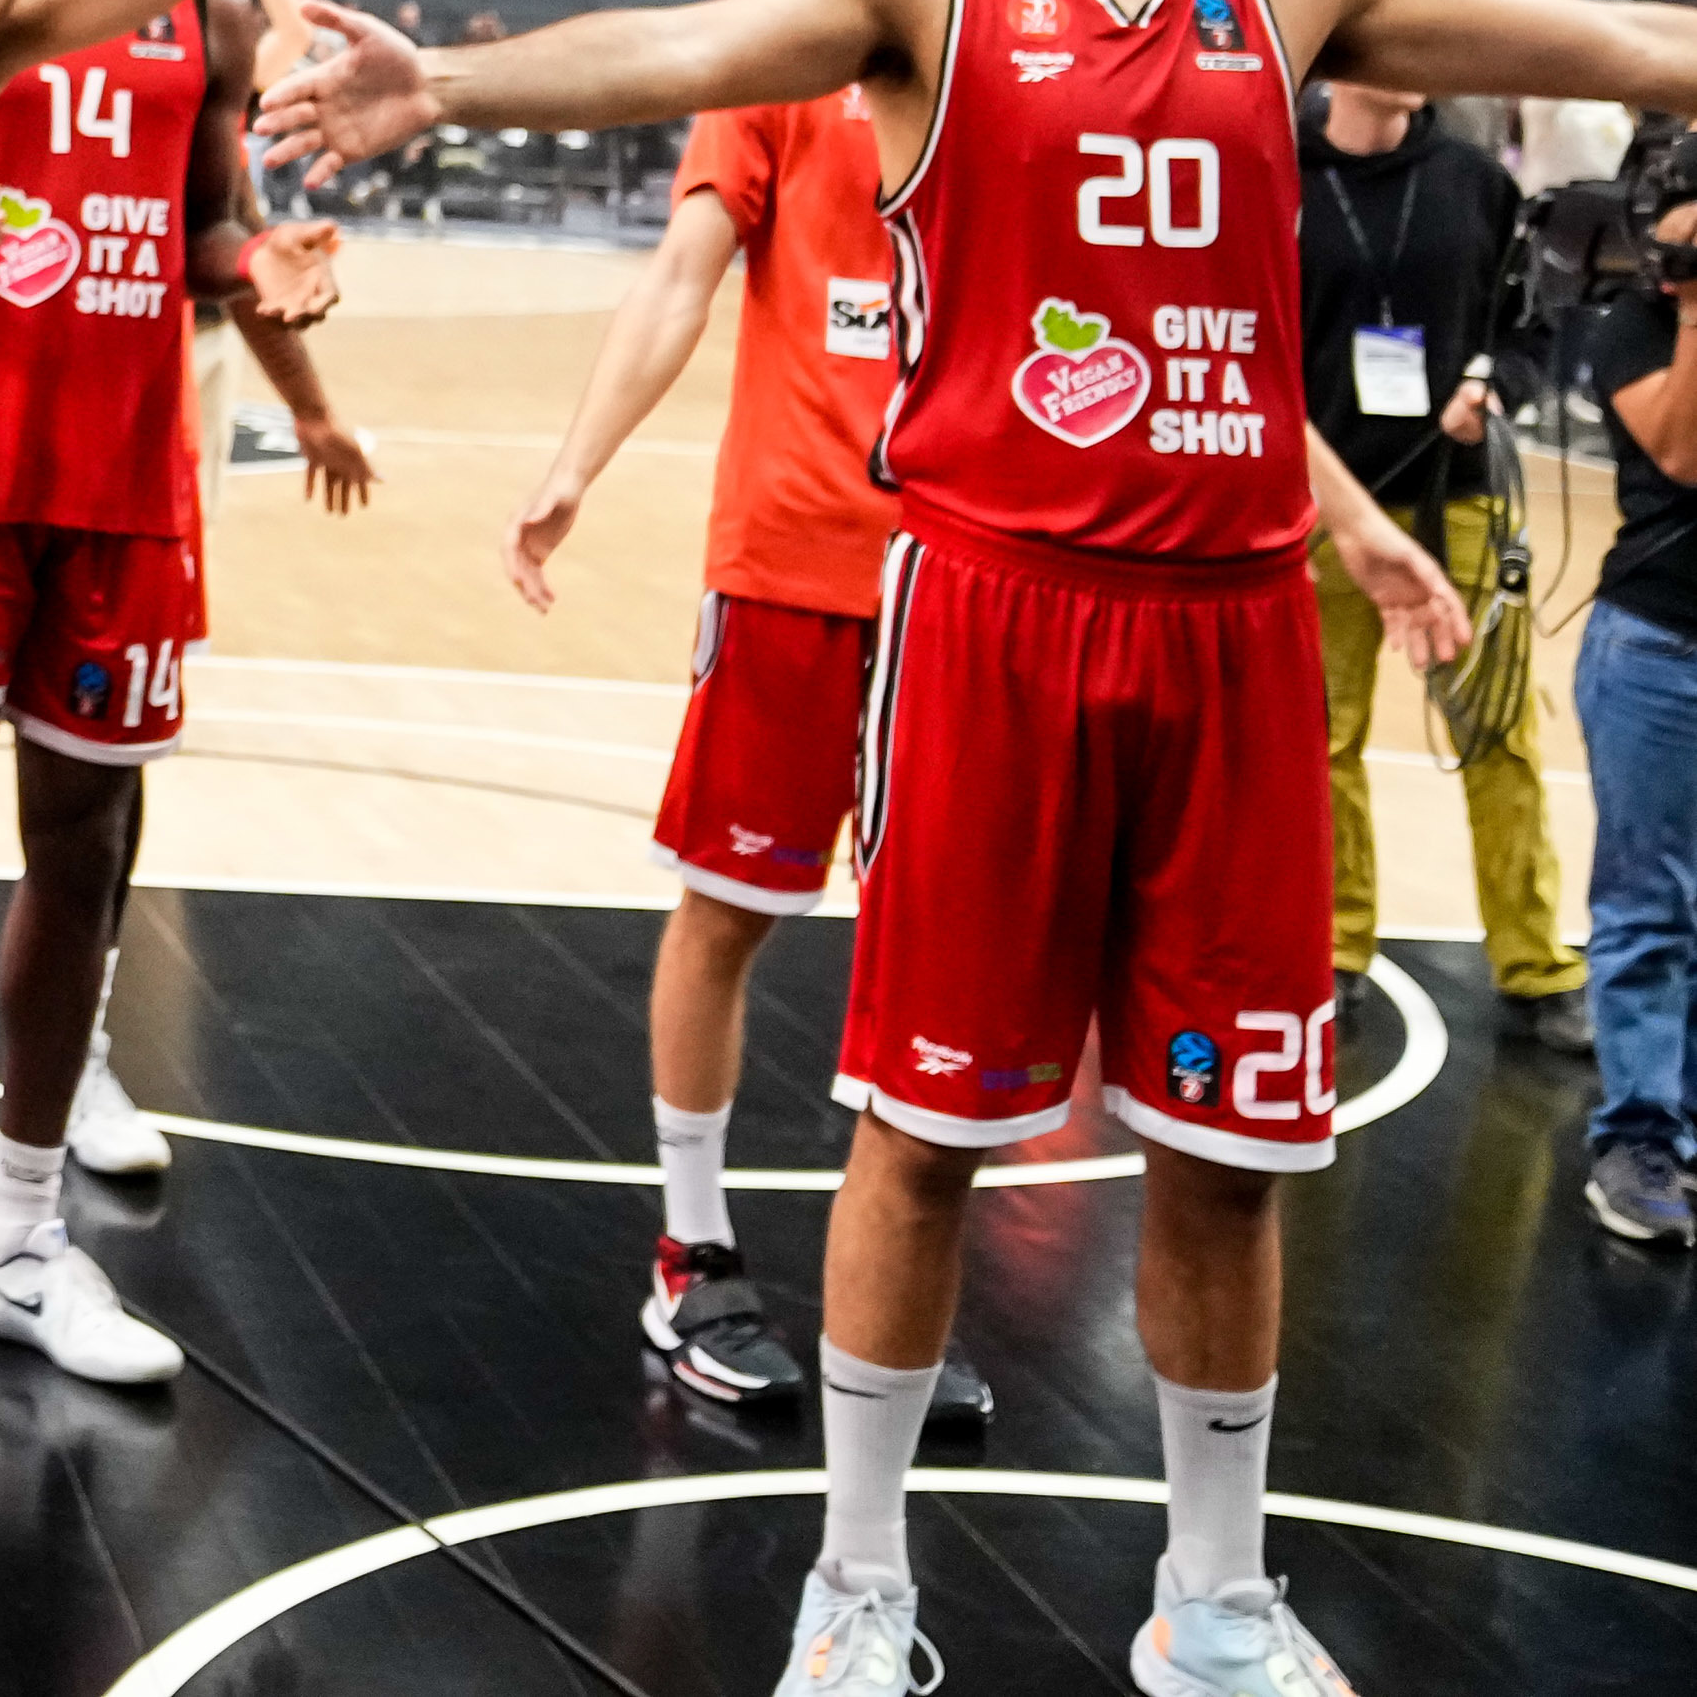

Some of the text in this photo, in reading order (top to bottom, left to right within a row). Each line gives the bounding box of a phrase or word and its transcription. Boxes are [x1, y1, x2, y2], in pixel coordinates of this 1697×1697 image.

[39, 63, 133, 158] 14
[81, 193, 170, 236] GIVE
[1077, 132, 1221, 248] 20
[88, 236, 129, 274] IT
[132, 240, 160, 276] A
[75, 276, 168, 319] SHOT
[1153, 304, 1258, 354] GIVE
[1166, 357, 1252, 405] IT A
[1149, 408, 1266, 458] SHOT
[122, 638, 180, 729] 14
